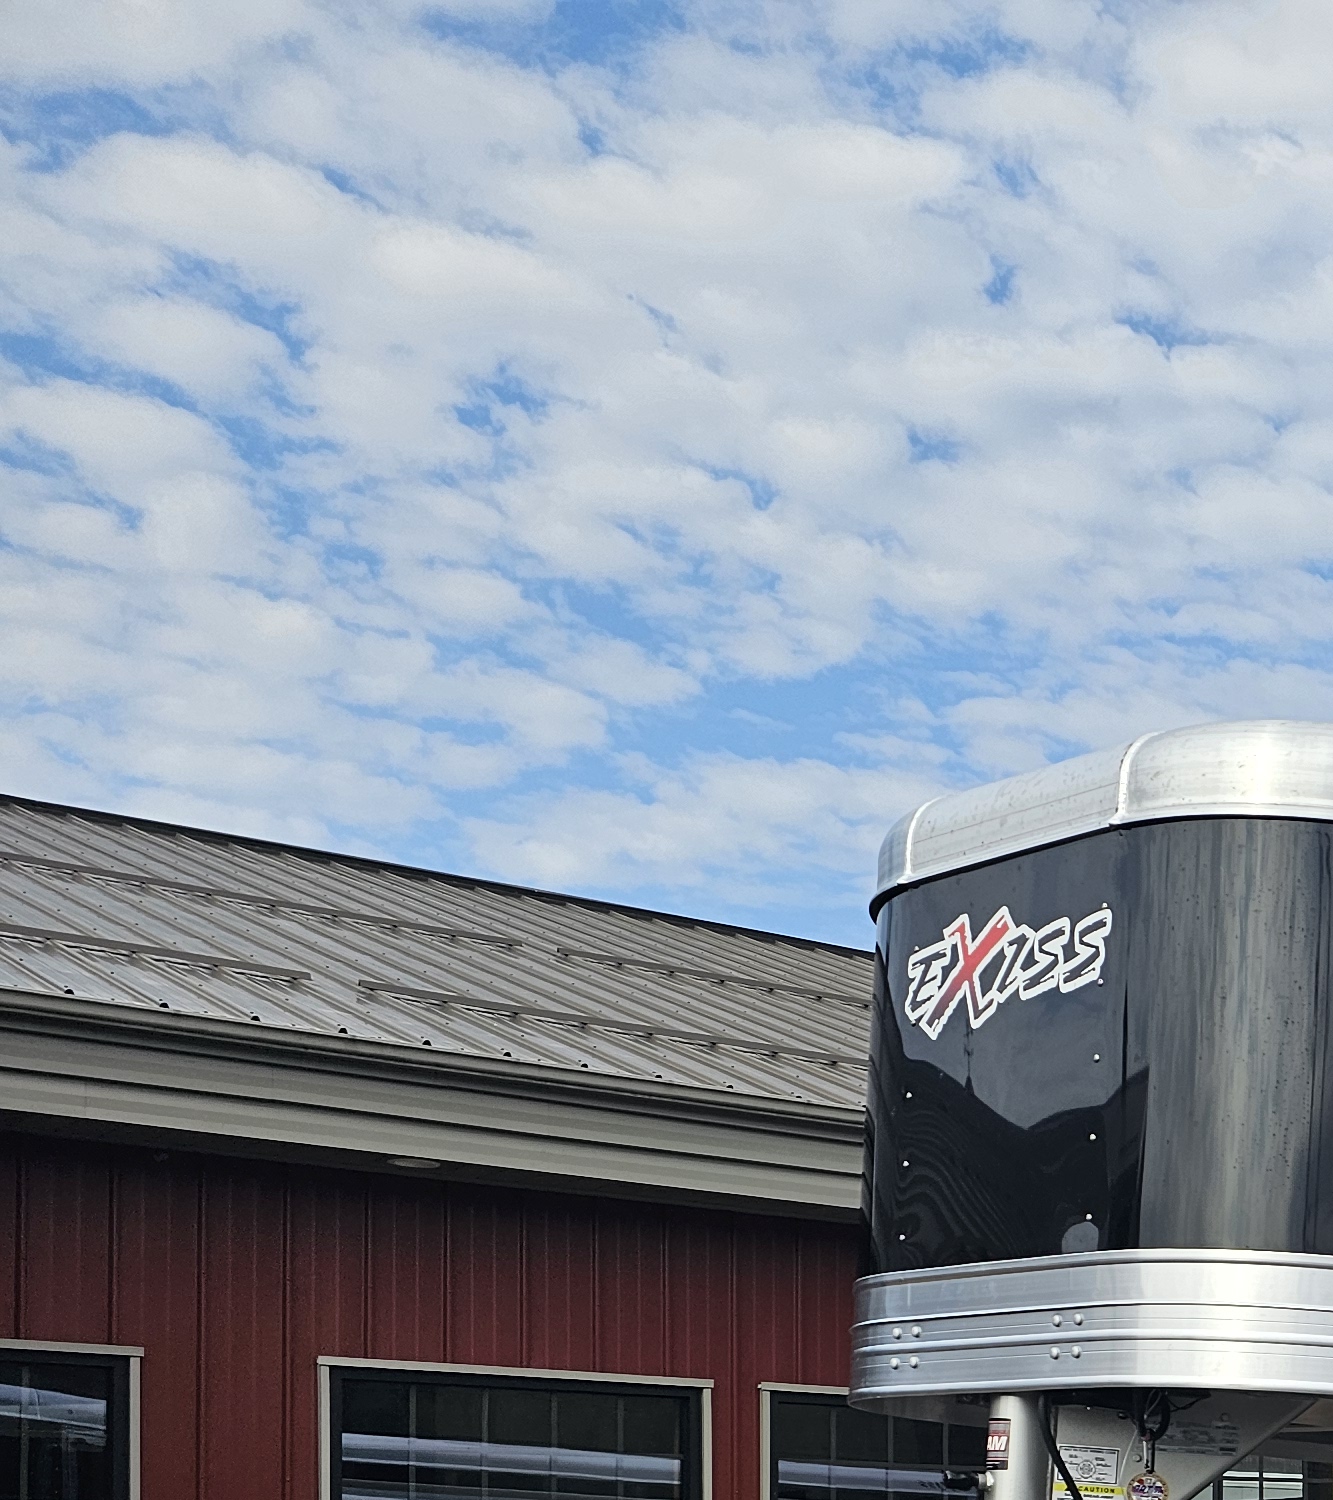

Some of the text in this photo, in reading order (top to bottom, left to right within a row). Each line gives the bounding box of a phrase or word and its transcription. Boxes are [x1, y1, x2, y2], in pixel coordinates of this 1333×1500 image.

[905, 906, 1112, 1040] EXISS
[987, 1435, 1008, 1451] AM
[1078, 1486, 1115, 1494] CAUTION
